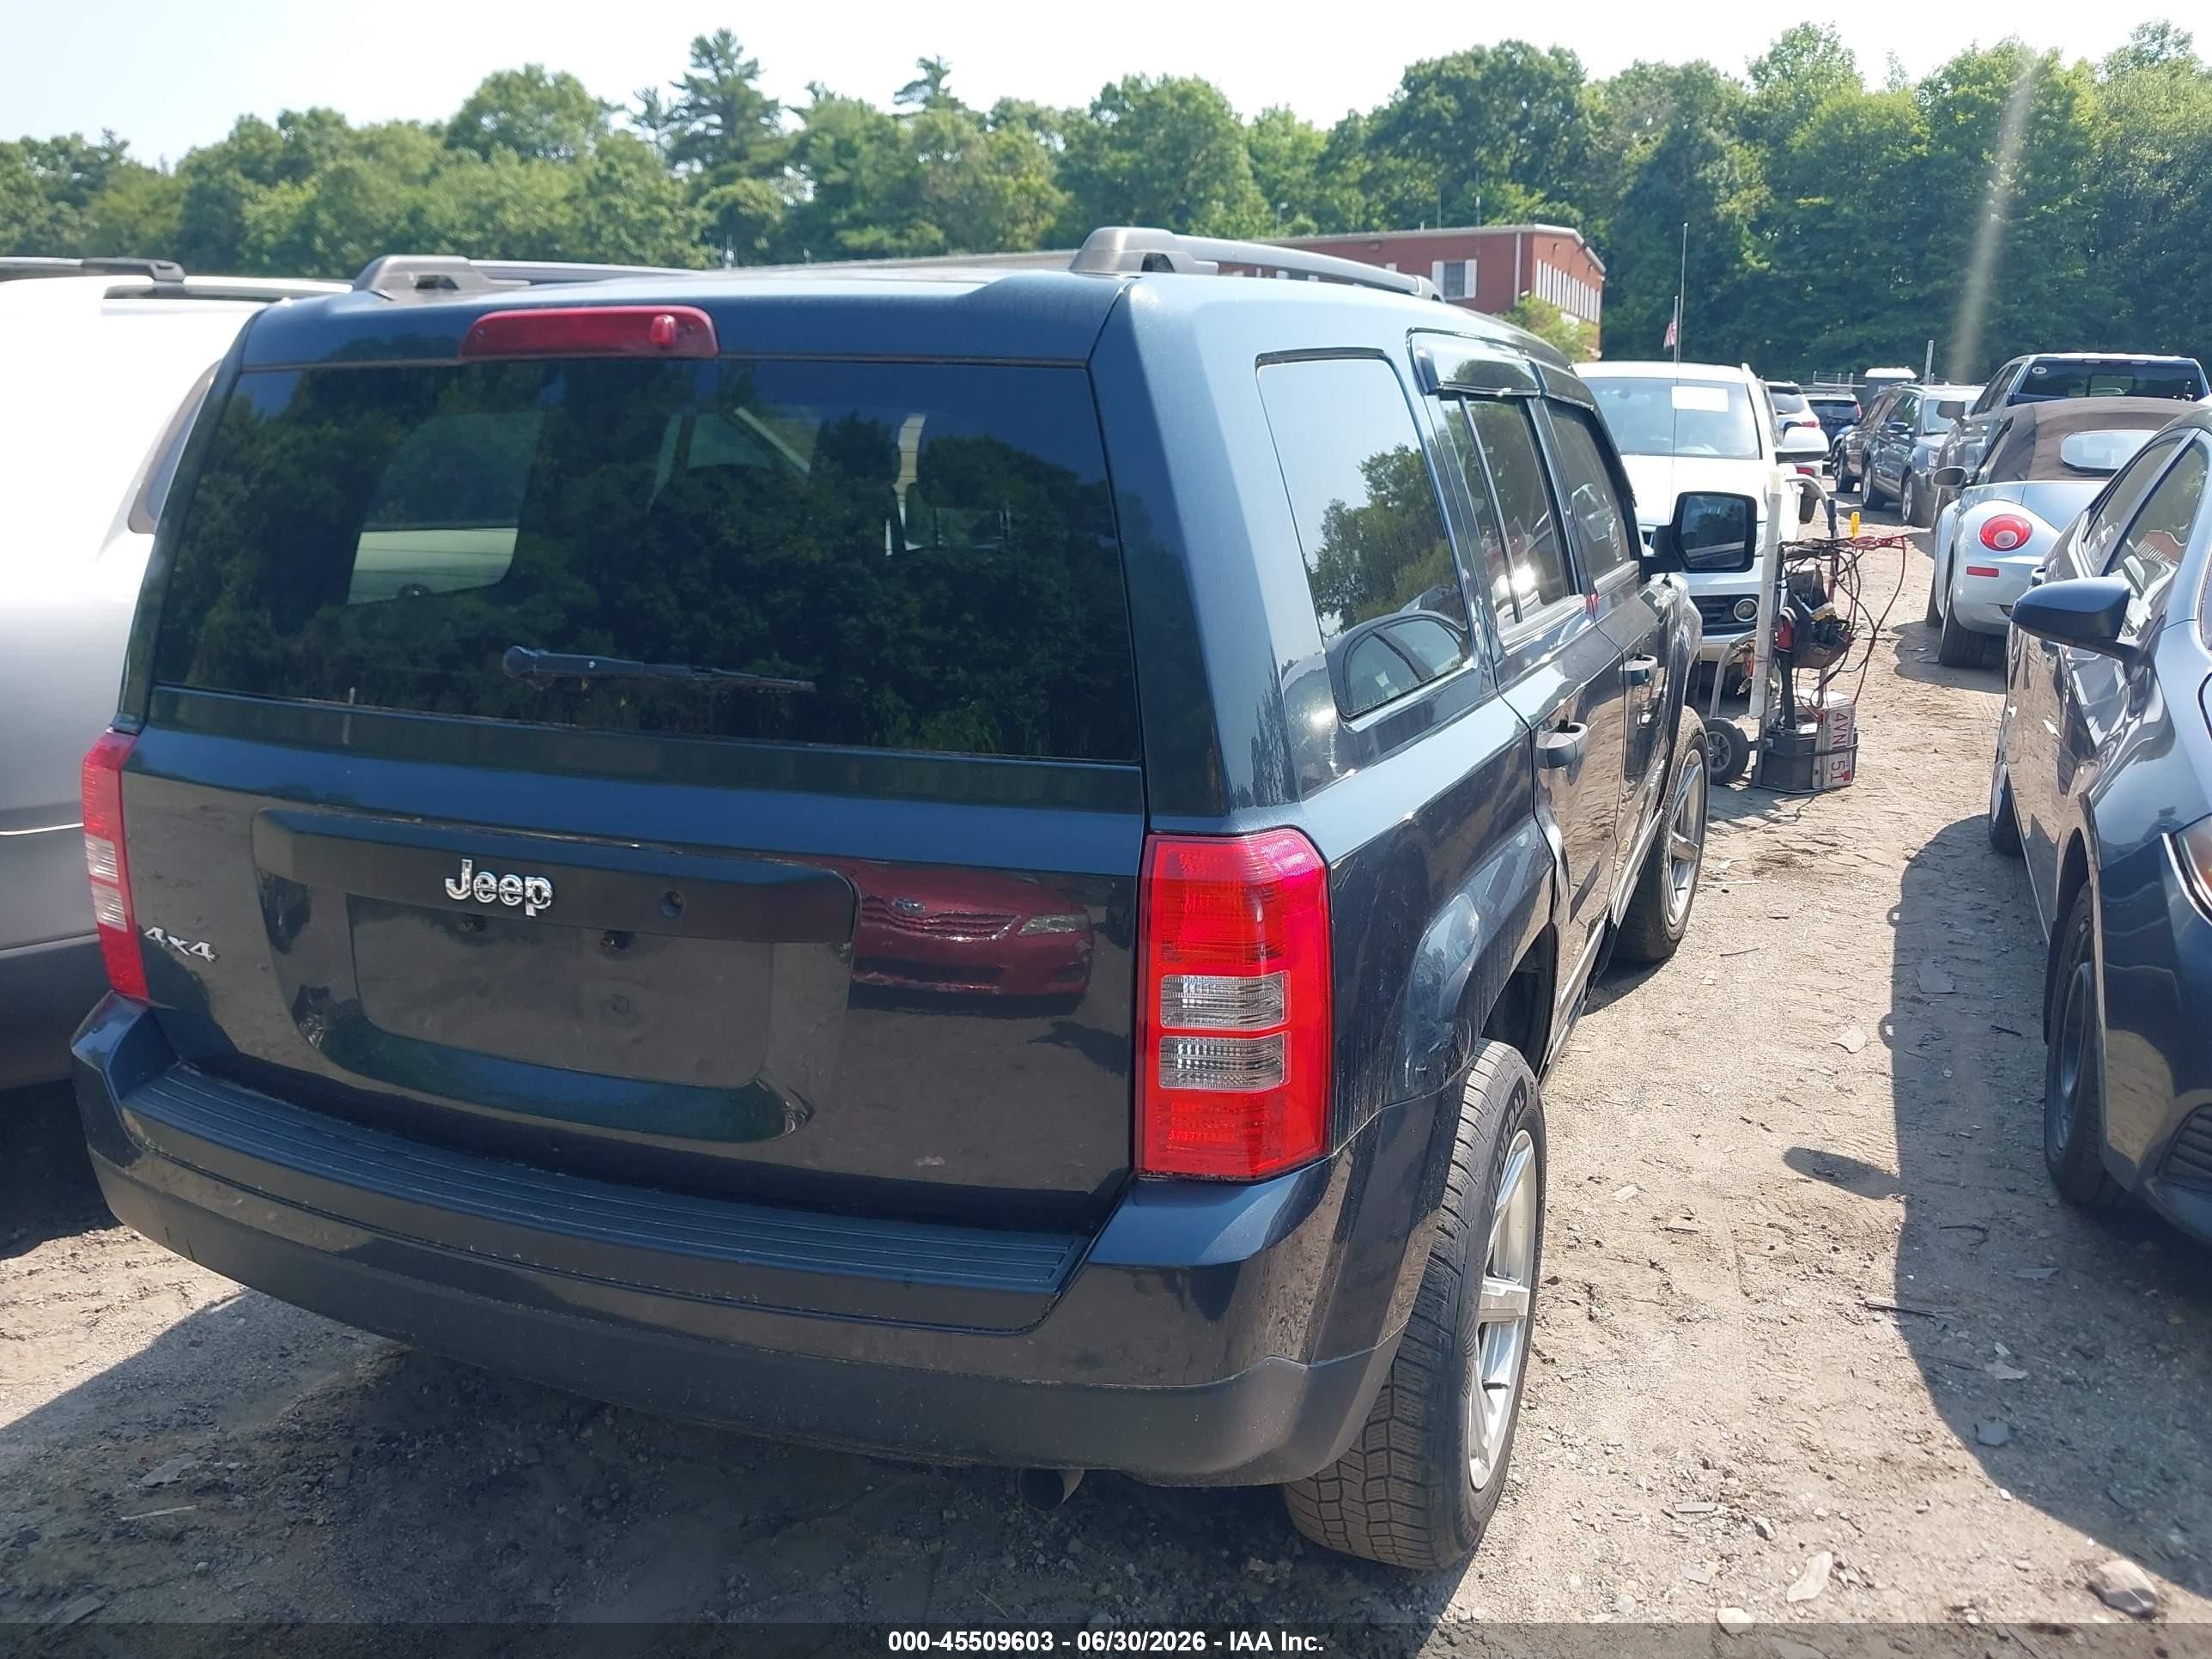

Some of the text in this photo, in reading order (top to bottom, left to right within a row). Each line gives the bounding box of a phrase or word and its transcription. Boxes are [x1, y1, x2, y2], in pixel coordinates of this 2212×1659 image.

[444, 858, 553, 917] Jeep
[143, 926, 216, 963] 4x4
[1487, 1089, 1526, 1218] GENERAL
